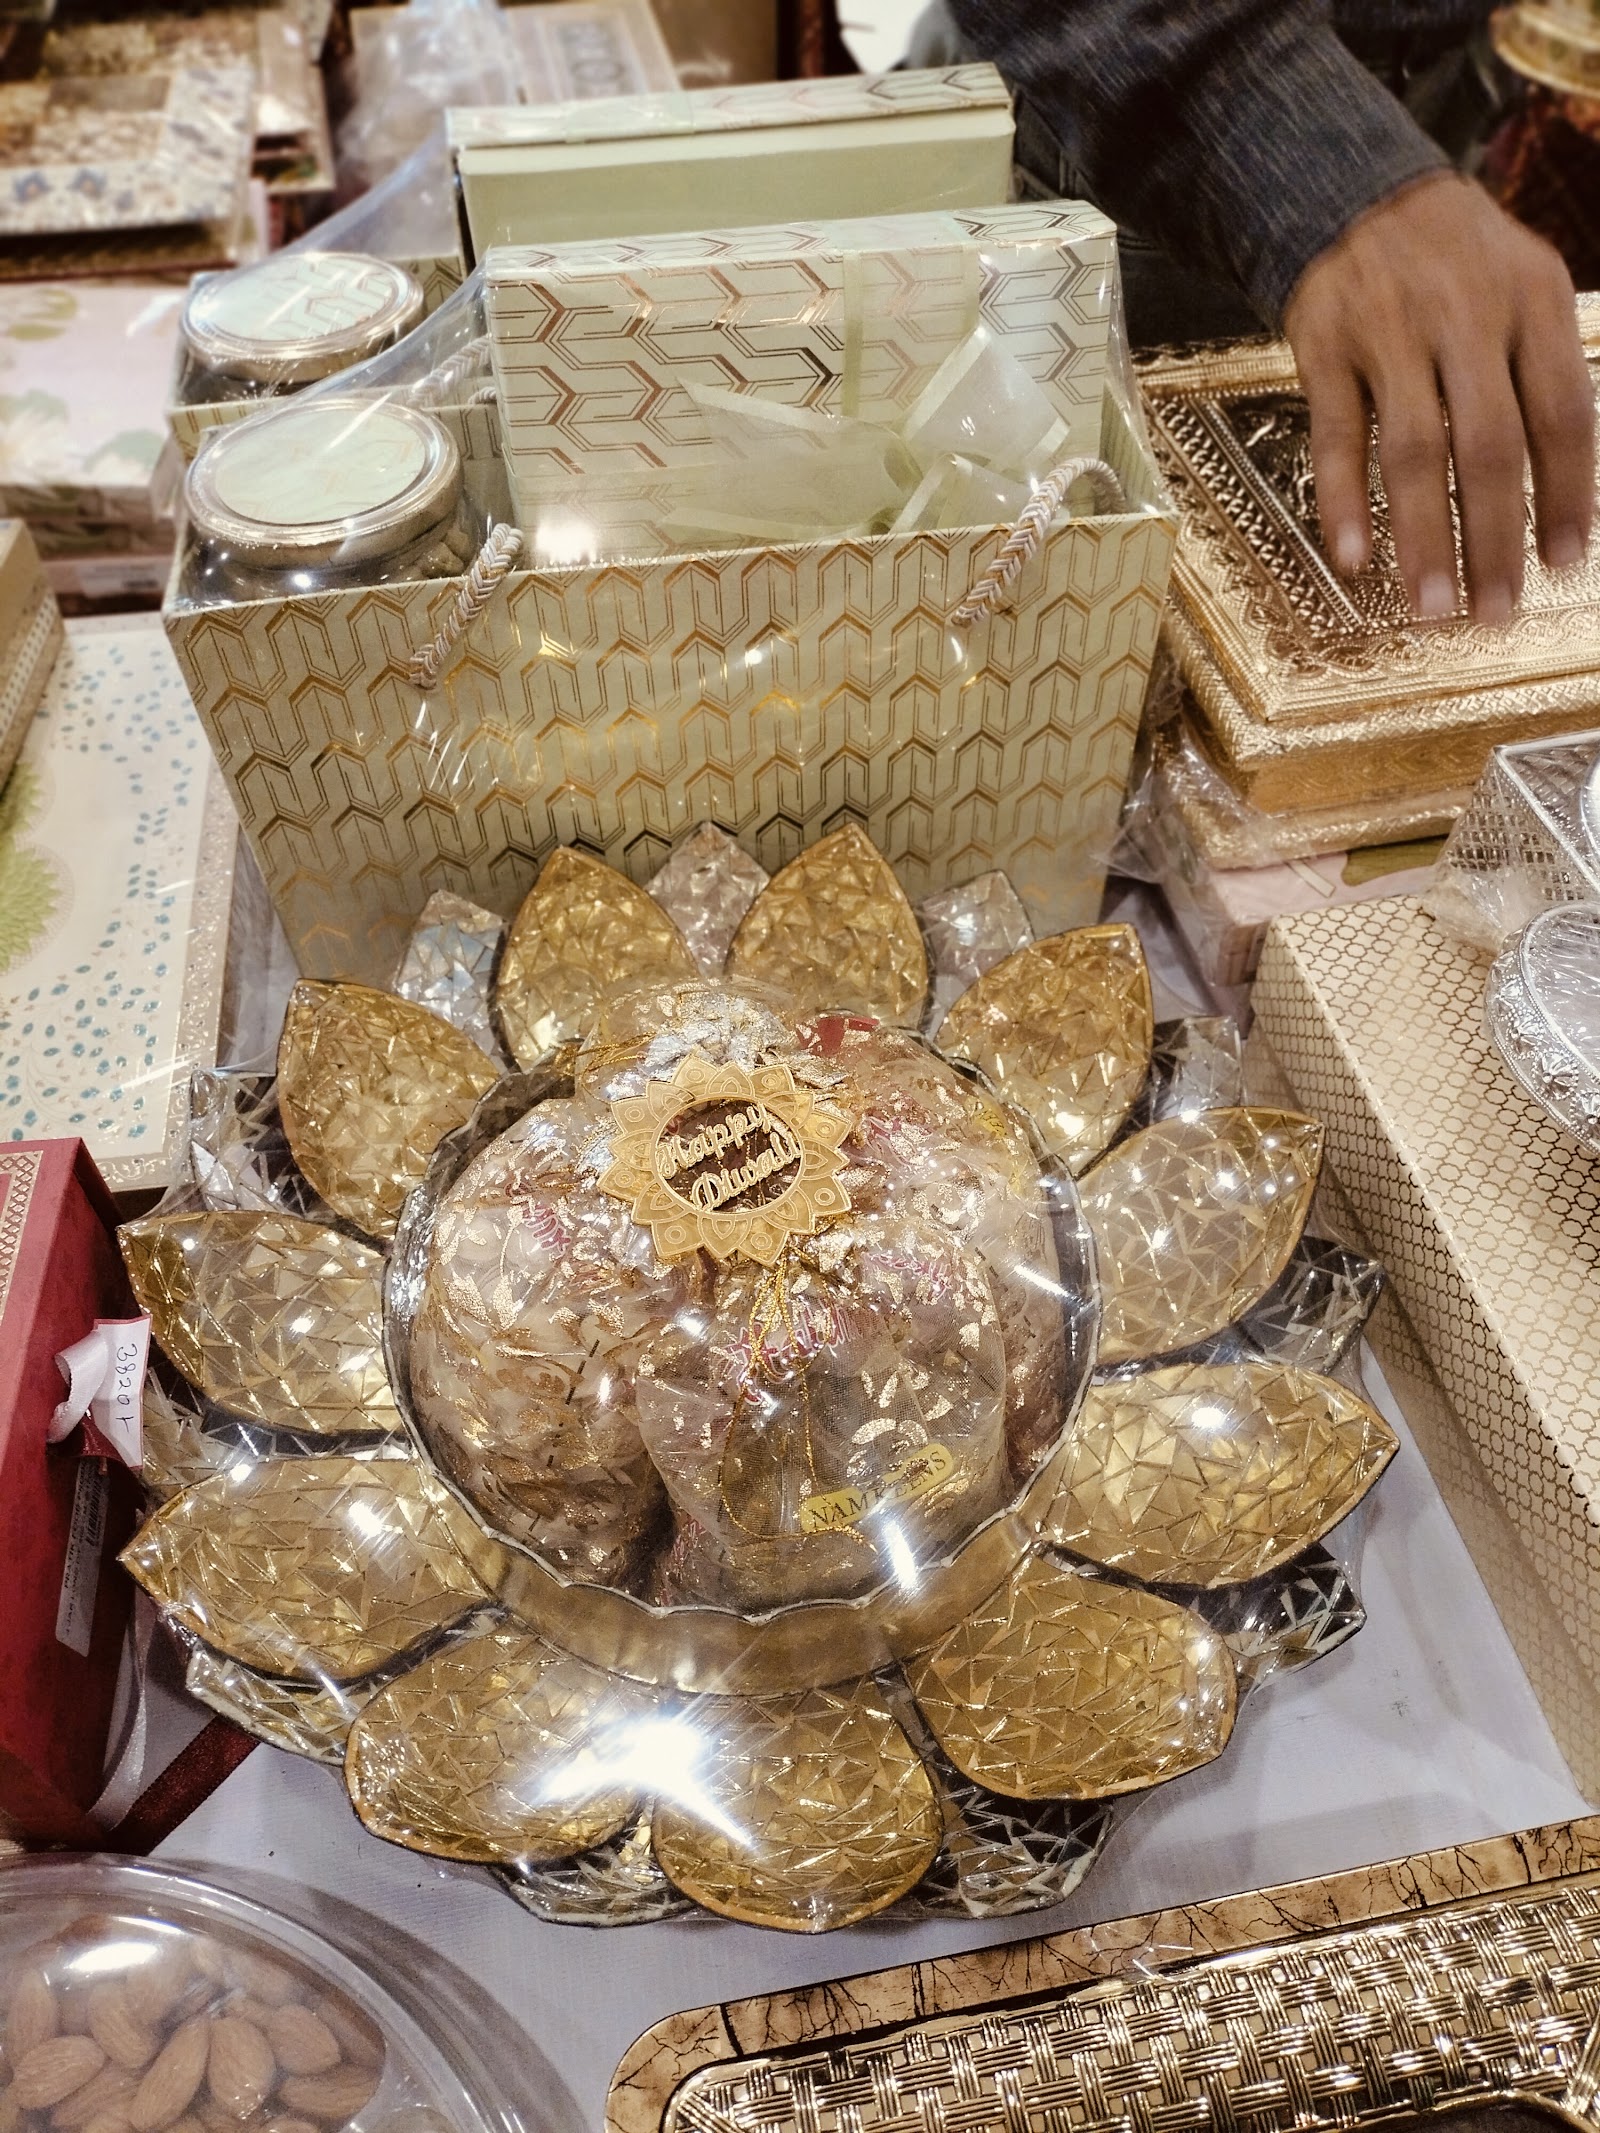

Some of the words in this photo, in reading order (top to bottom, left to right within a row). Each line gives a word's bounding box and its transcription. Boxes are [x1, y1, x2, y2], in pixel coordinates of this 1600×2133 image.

[656, 1103, 772, 1180] Happy
[690, 1131, 801, 1212] Diwali
[809, 1451, 947, 1528] NAMKEENS
